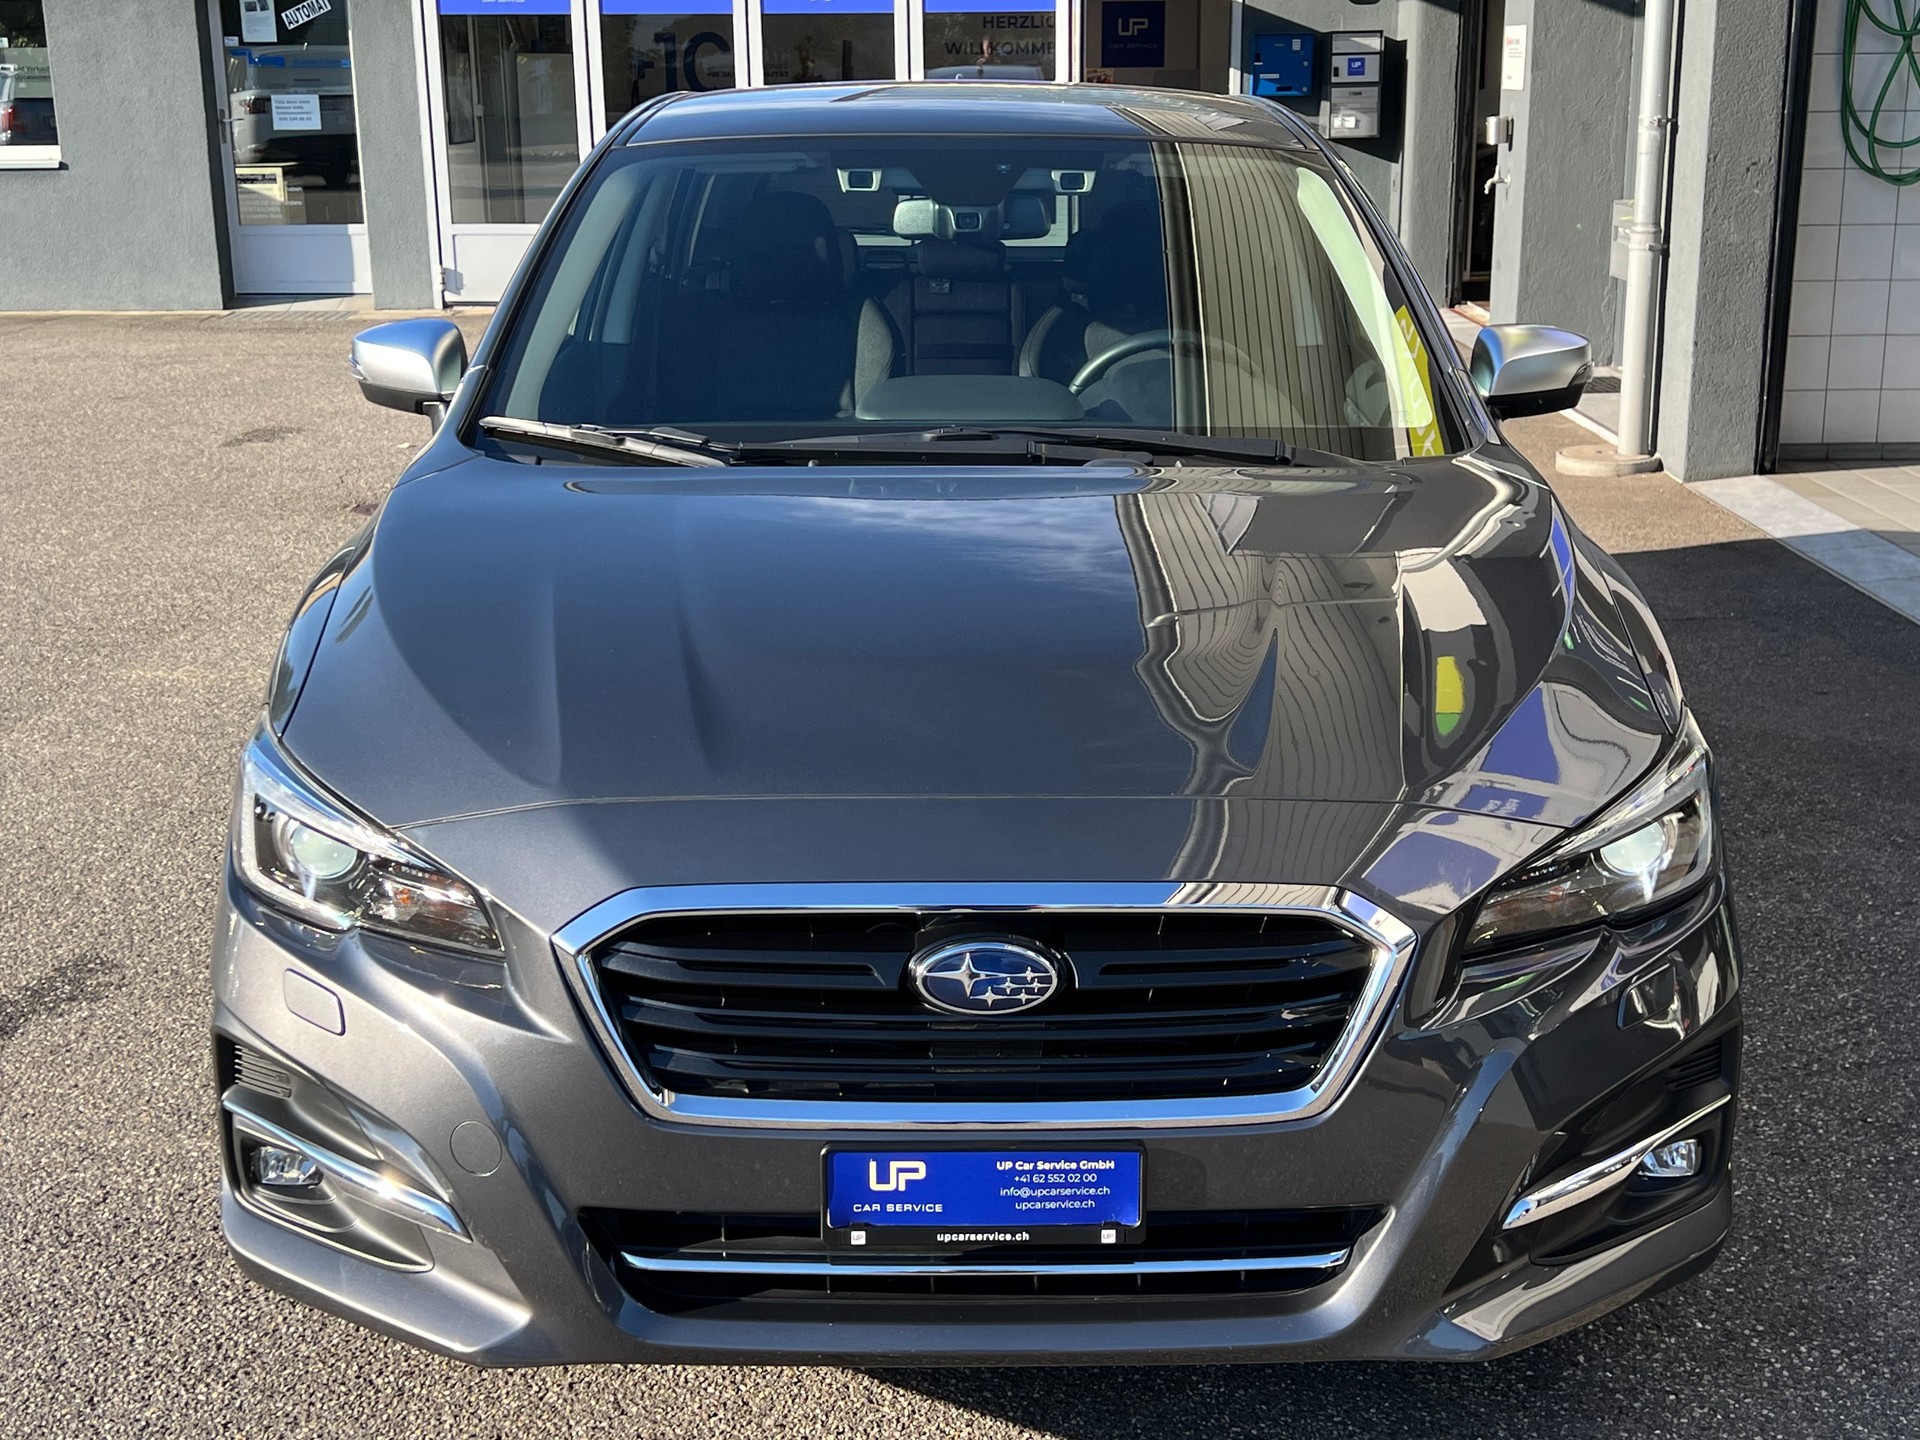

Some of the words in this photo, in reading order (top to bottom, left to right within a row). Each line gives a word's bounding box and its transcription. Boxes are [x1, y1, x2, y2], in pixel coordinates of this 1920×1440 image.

[285, 0, 328, 27] AUTOMAT
[1118, 17, 1149, 36] UP
[996, 1160, 1013, 1171] UP
[1015, 1160, 1035, 1171] Car
[1037, 1160, 1077, 1171] Service
[1079, 1160, 1115, 1171] GmbH
[869, 1159, 927, 1191] UP
[1014, 1173, 1031, 1183] +41
[1032, 1173, 1045, 1183] 62
[1047, 1173, 1066, 1183] 552
[1068, 1172, 1082, 1182] 02
[1083, 1172, 1098, 1182] 00
[1000, 1185, 1111, 1198] info@upcarservice.ch
[853, 1203, 881, 1213] CAR
[886, 1203, 943, 1213] SERVICE
[1015, 1199, 1095, 1211] upcarservice.ch
[936, 1231, 1030, 1243] upcarservice.ch
